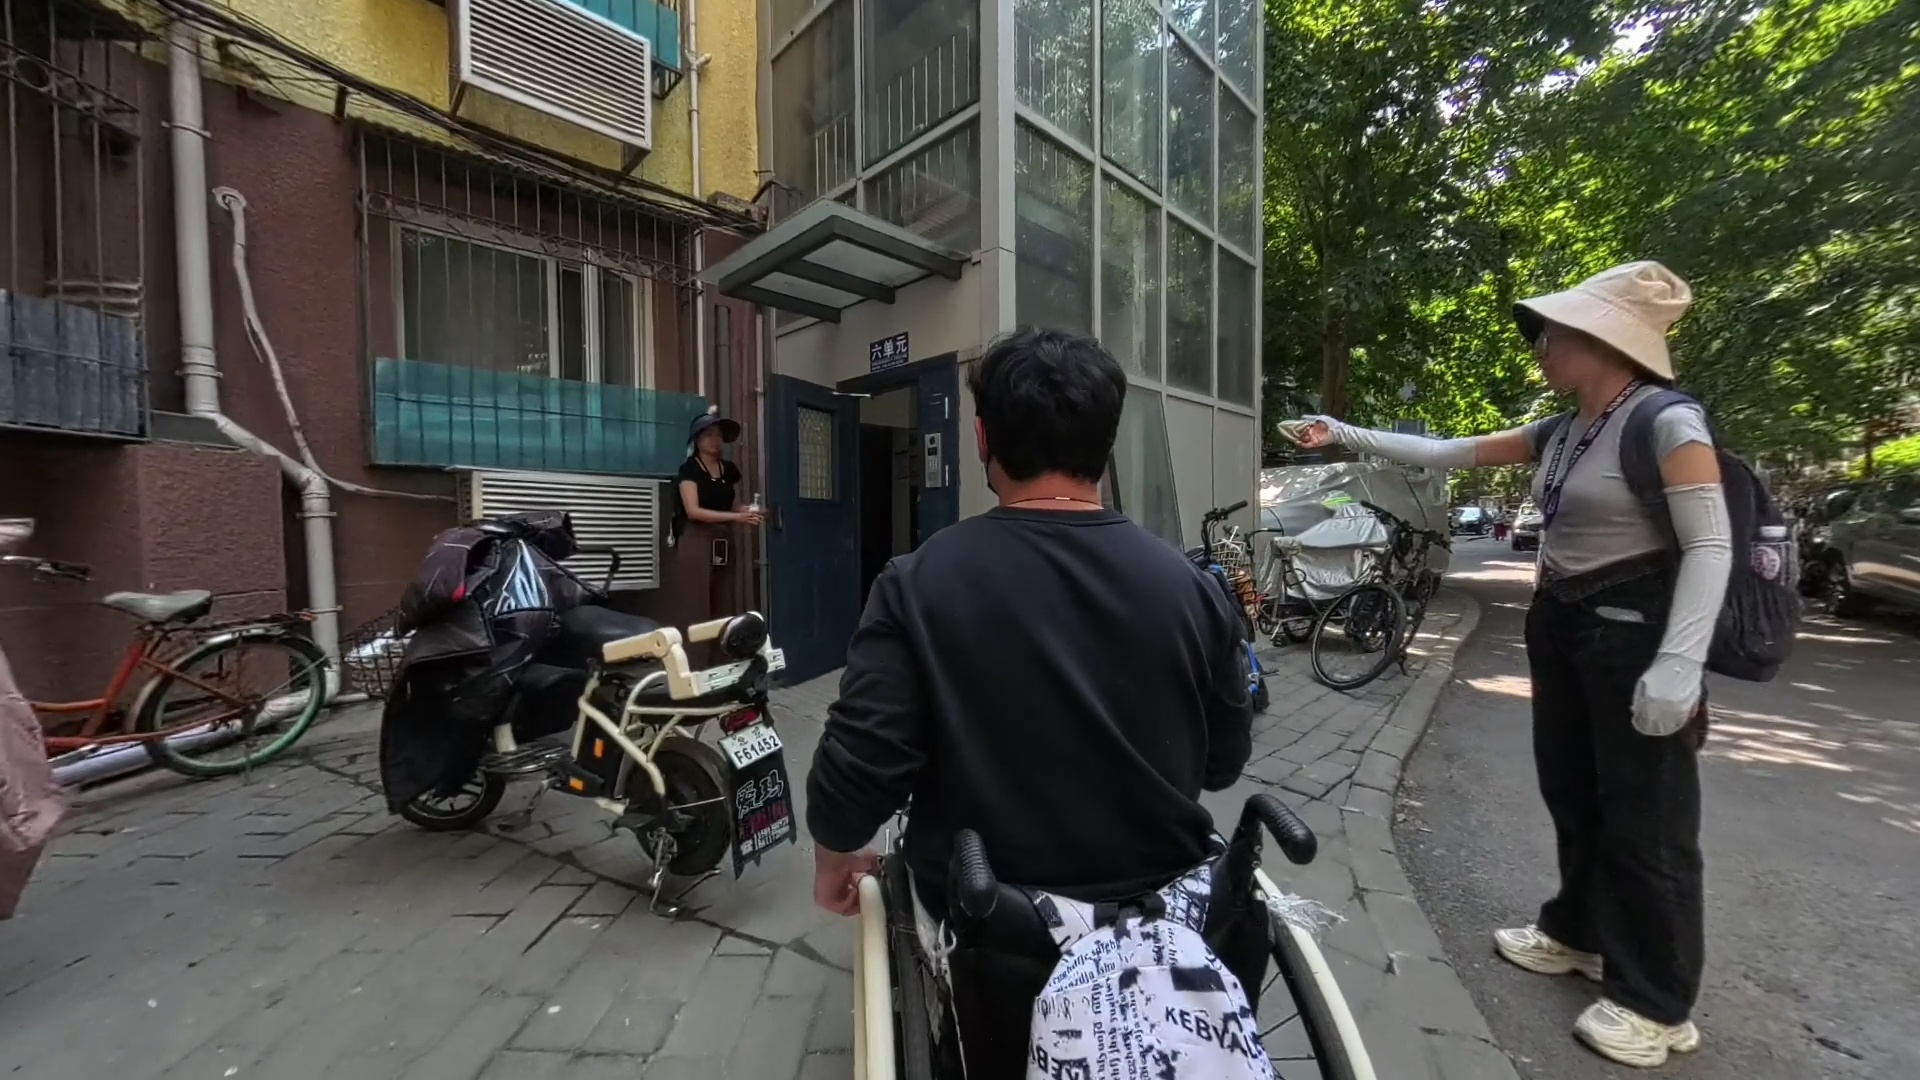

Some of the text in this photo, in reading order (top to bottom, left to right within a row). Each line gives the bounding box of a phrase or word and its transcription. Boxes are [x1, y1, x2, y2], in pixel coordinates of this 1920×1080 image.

[871, 335, 907, 360] 六单元
[734, 735, 779, 764] F61452
